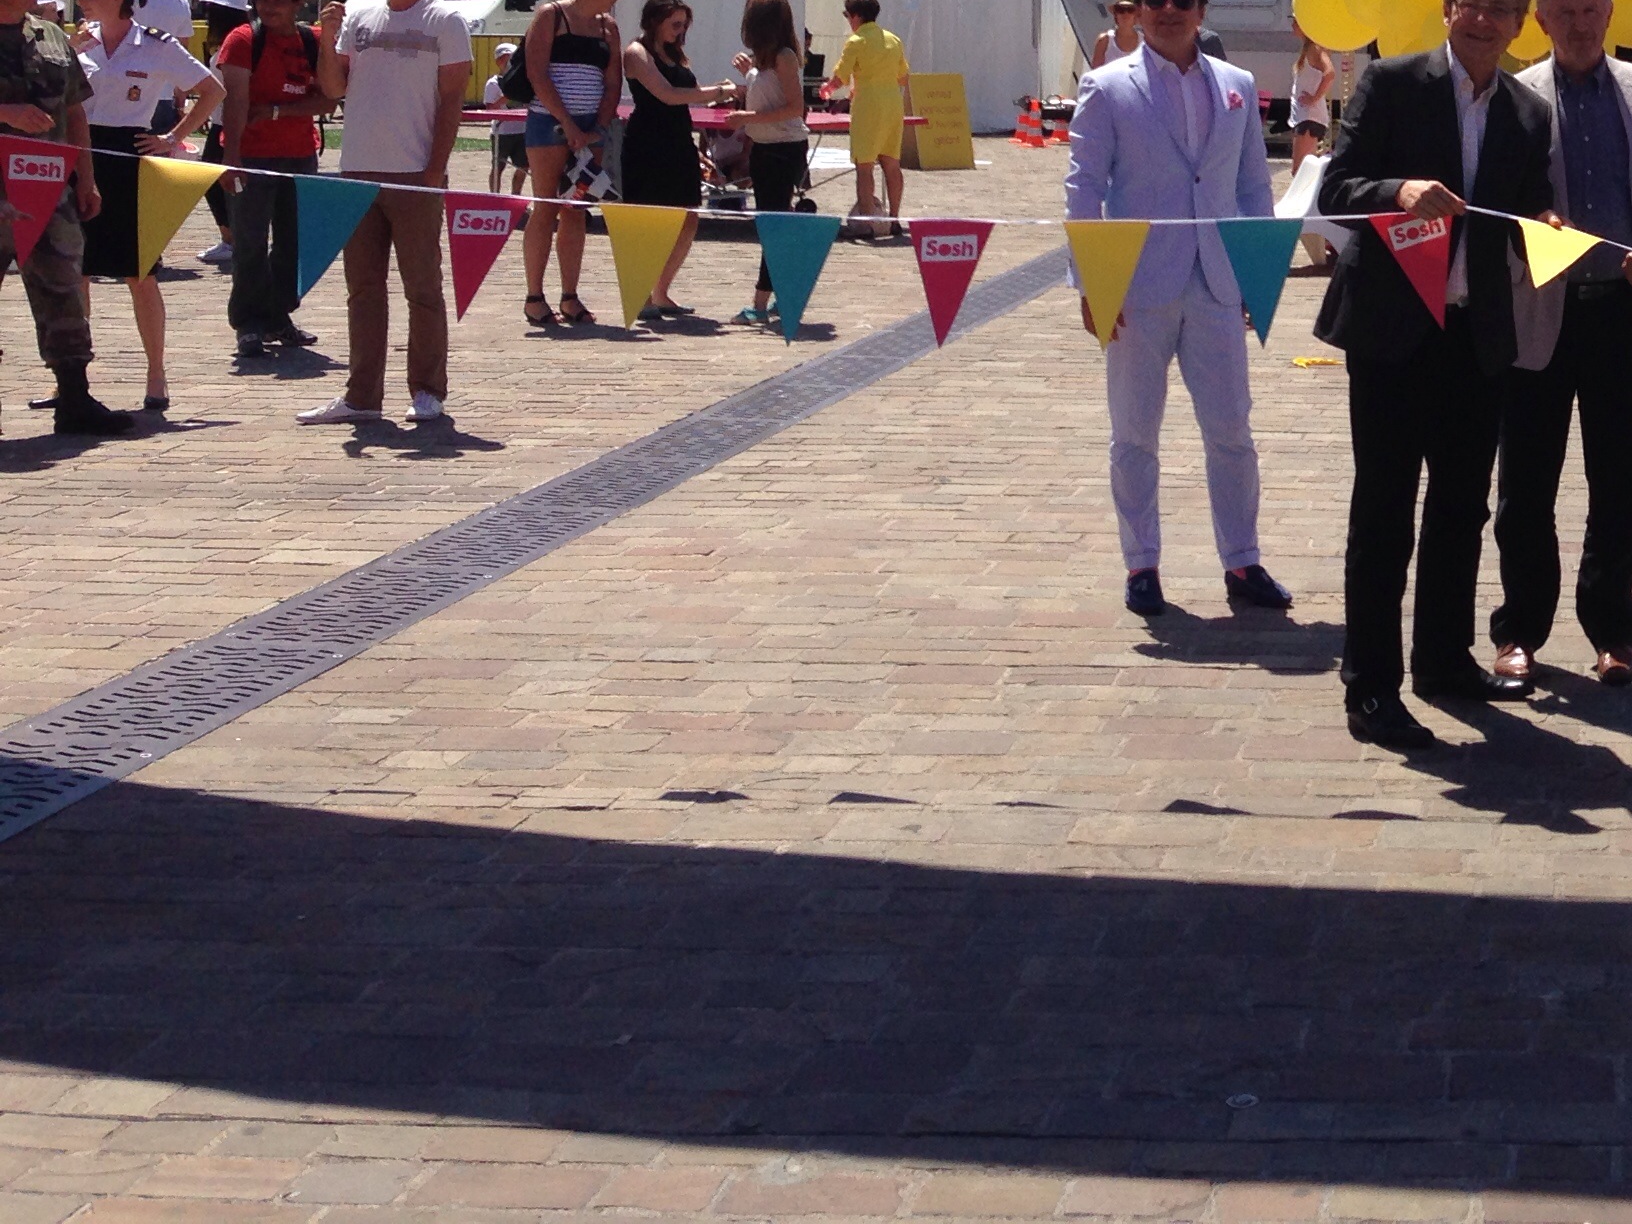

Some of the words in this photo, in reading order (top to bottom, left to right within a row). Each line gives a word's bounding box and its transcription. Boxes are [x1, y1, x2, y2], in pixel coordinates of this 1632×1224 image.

[13, 156, 62, 180] Sosh
[456, 211, 506, 234] Sosh
[1394, 219, 1443, 244] Sosh
[925, 238, 975, 258] Sosh
